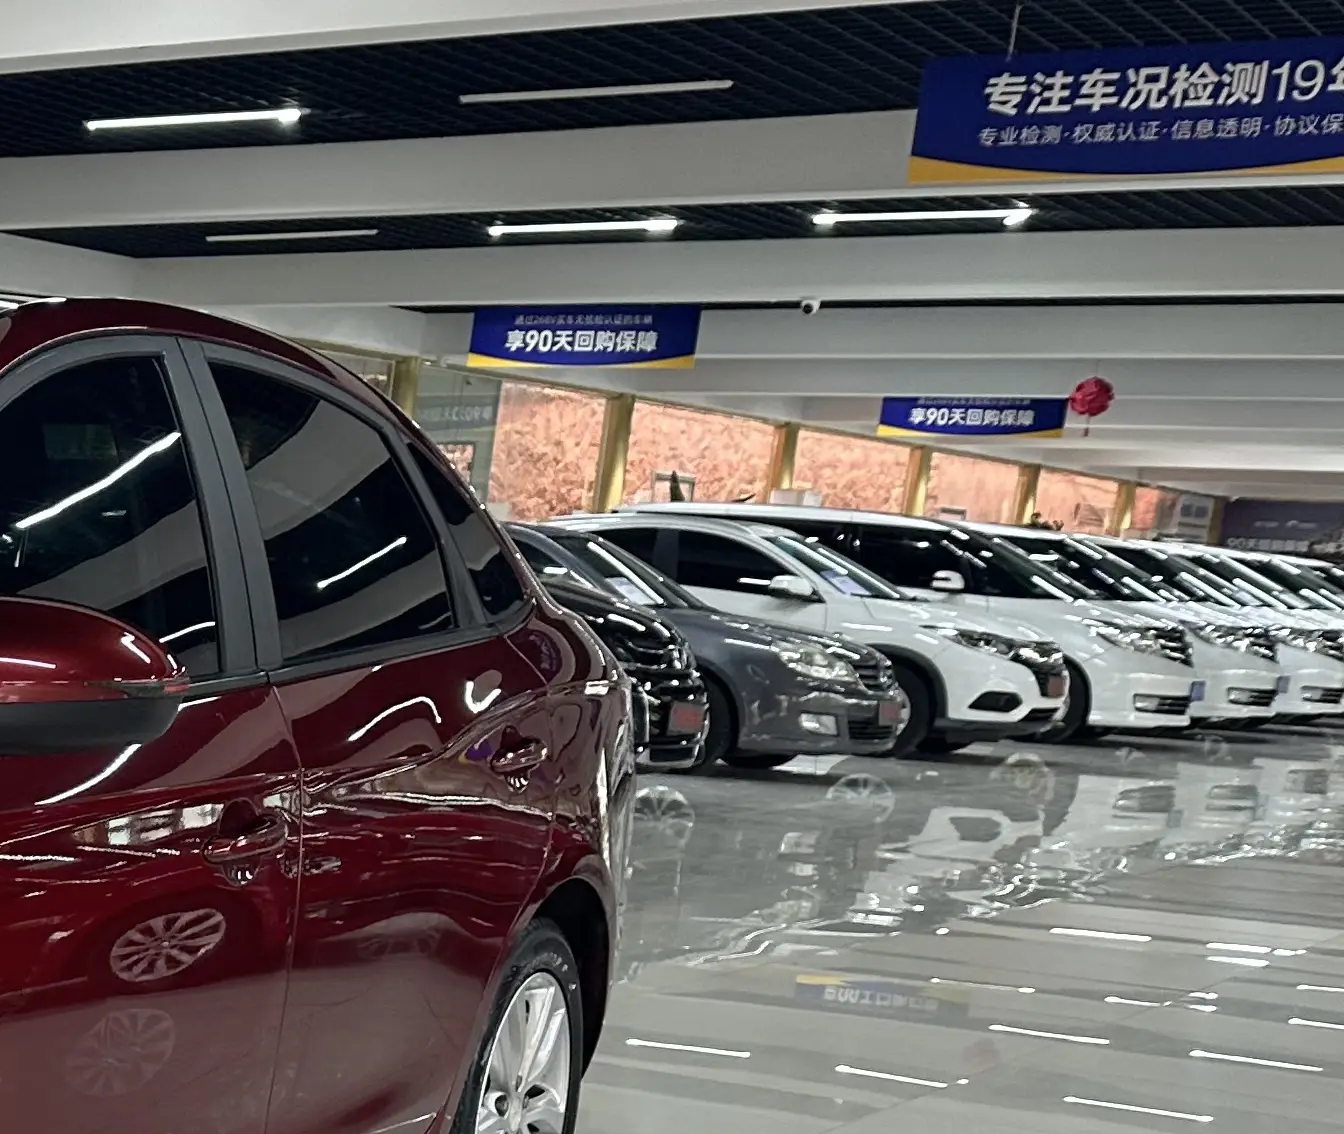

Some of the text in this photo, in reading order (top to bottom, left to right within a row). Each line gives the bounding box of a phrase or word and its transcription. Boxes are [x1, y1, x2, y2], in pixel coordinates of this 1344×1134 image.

[505, 329, 658, 353] 享90天回购保障
[908, 407, 1035, 426] 享90天回购保障
